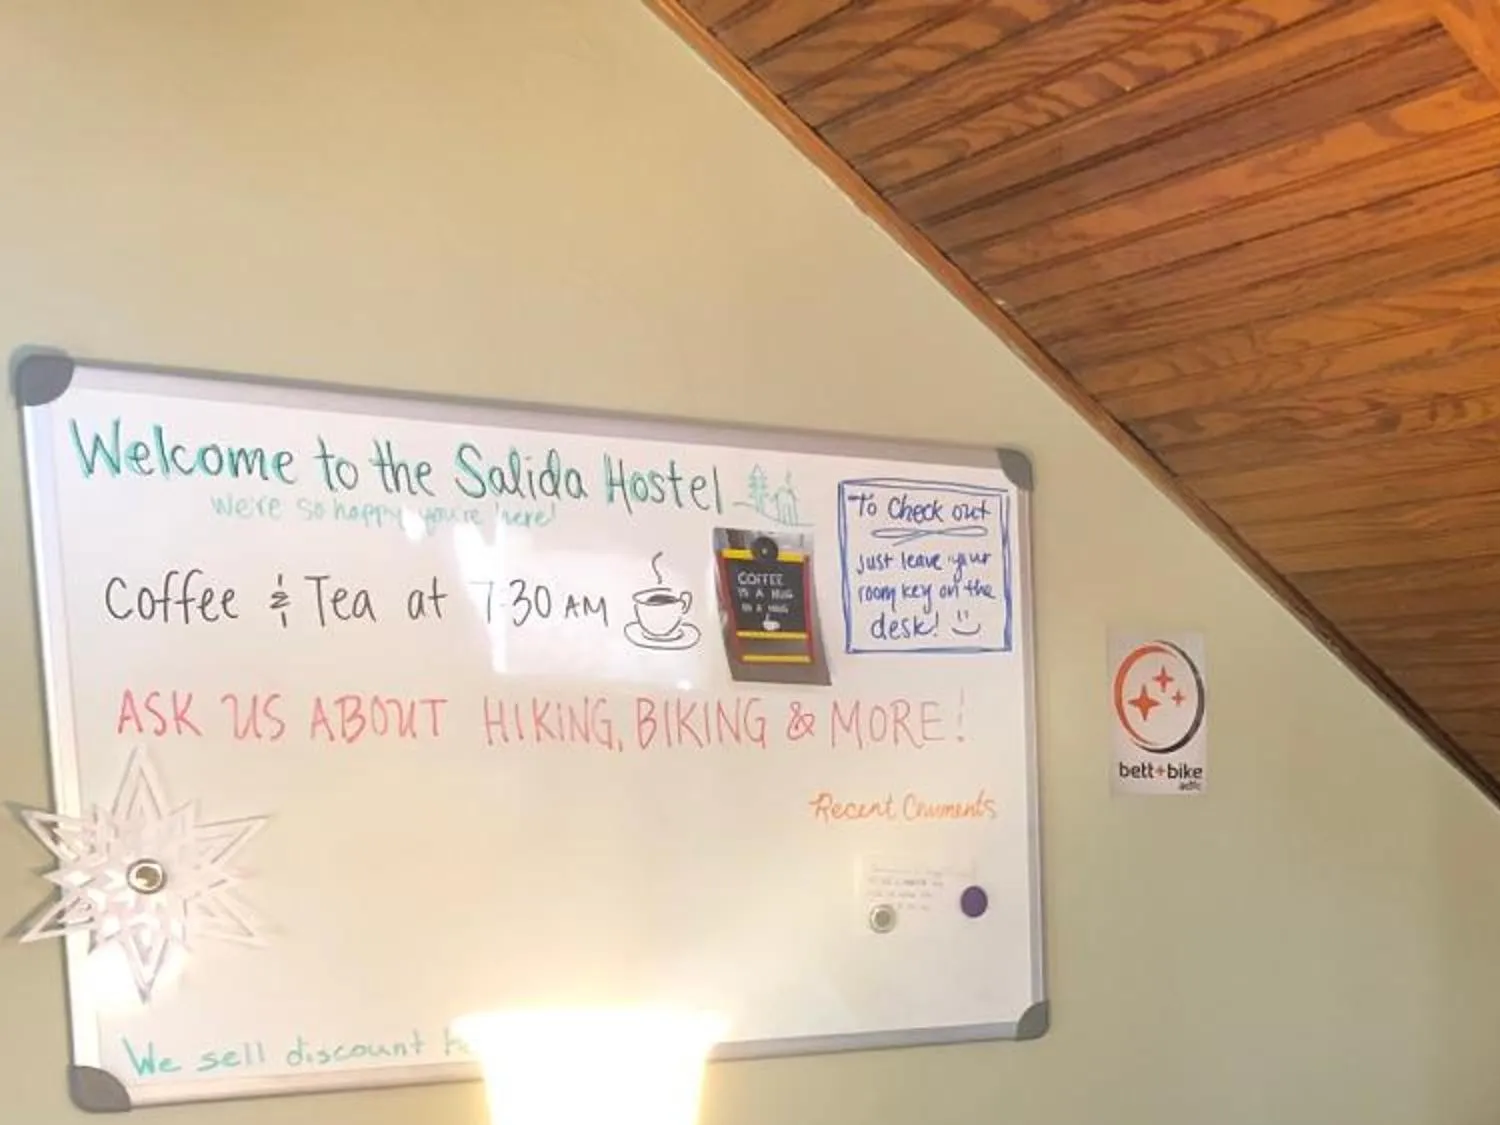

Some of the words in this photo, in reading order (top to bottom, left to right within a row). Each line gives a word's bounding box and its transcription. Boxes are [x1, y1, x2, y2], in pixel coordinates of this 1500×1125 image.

[70, 417, 299, 484] Welcome
[316, 436, 359, 490] to
[370, 440, 435, 498] the
[455, 443, 588, 500] Salida
[603, 452, 723, 516] Hostel
[334, 498, 406, 531] happy
[848, 492, 877, 517] To
[888, 493, 943, 523] Check
[952, 499, 991, 521] out
[902, 552, 942, 571] leave
[738, 570, 784, 586] COFFEE
[755, 588, 765, 600] A
[105, 568, 239, 625] Coffee
[304, 575, 376, 627] Tea
[407, 575, 448, 620] at
[565, 594, 608, 627] AM
[858, 585, 897, 613] room
[902, 582, 932, 614] key
[939, 583, 959, 599] on
[964, 579, 996, 599] the
[871, 611, 939, 641] desk!
[117, 690, 202, 740] ASK
[221, 693, 287, 742] US
[309, 694, 449, 744] ABOUT
[636, 700, 767, 752] BIKING
[786, 706, 815, 741] &
[808, 792, 897, 824] Recent
[122, 1036, 181, 1076] We
[197, 1041, 264, 1072] sell
[286, 1029, 426, 1067] discount
